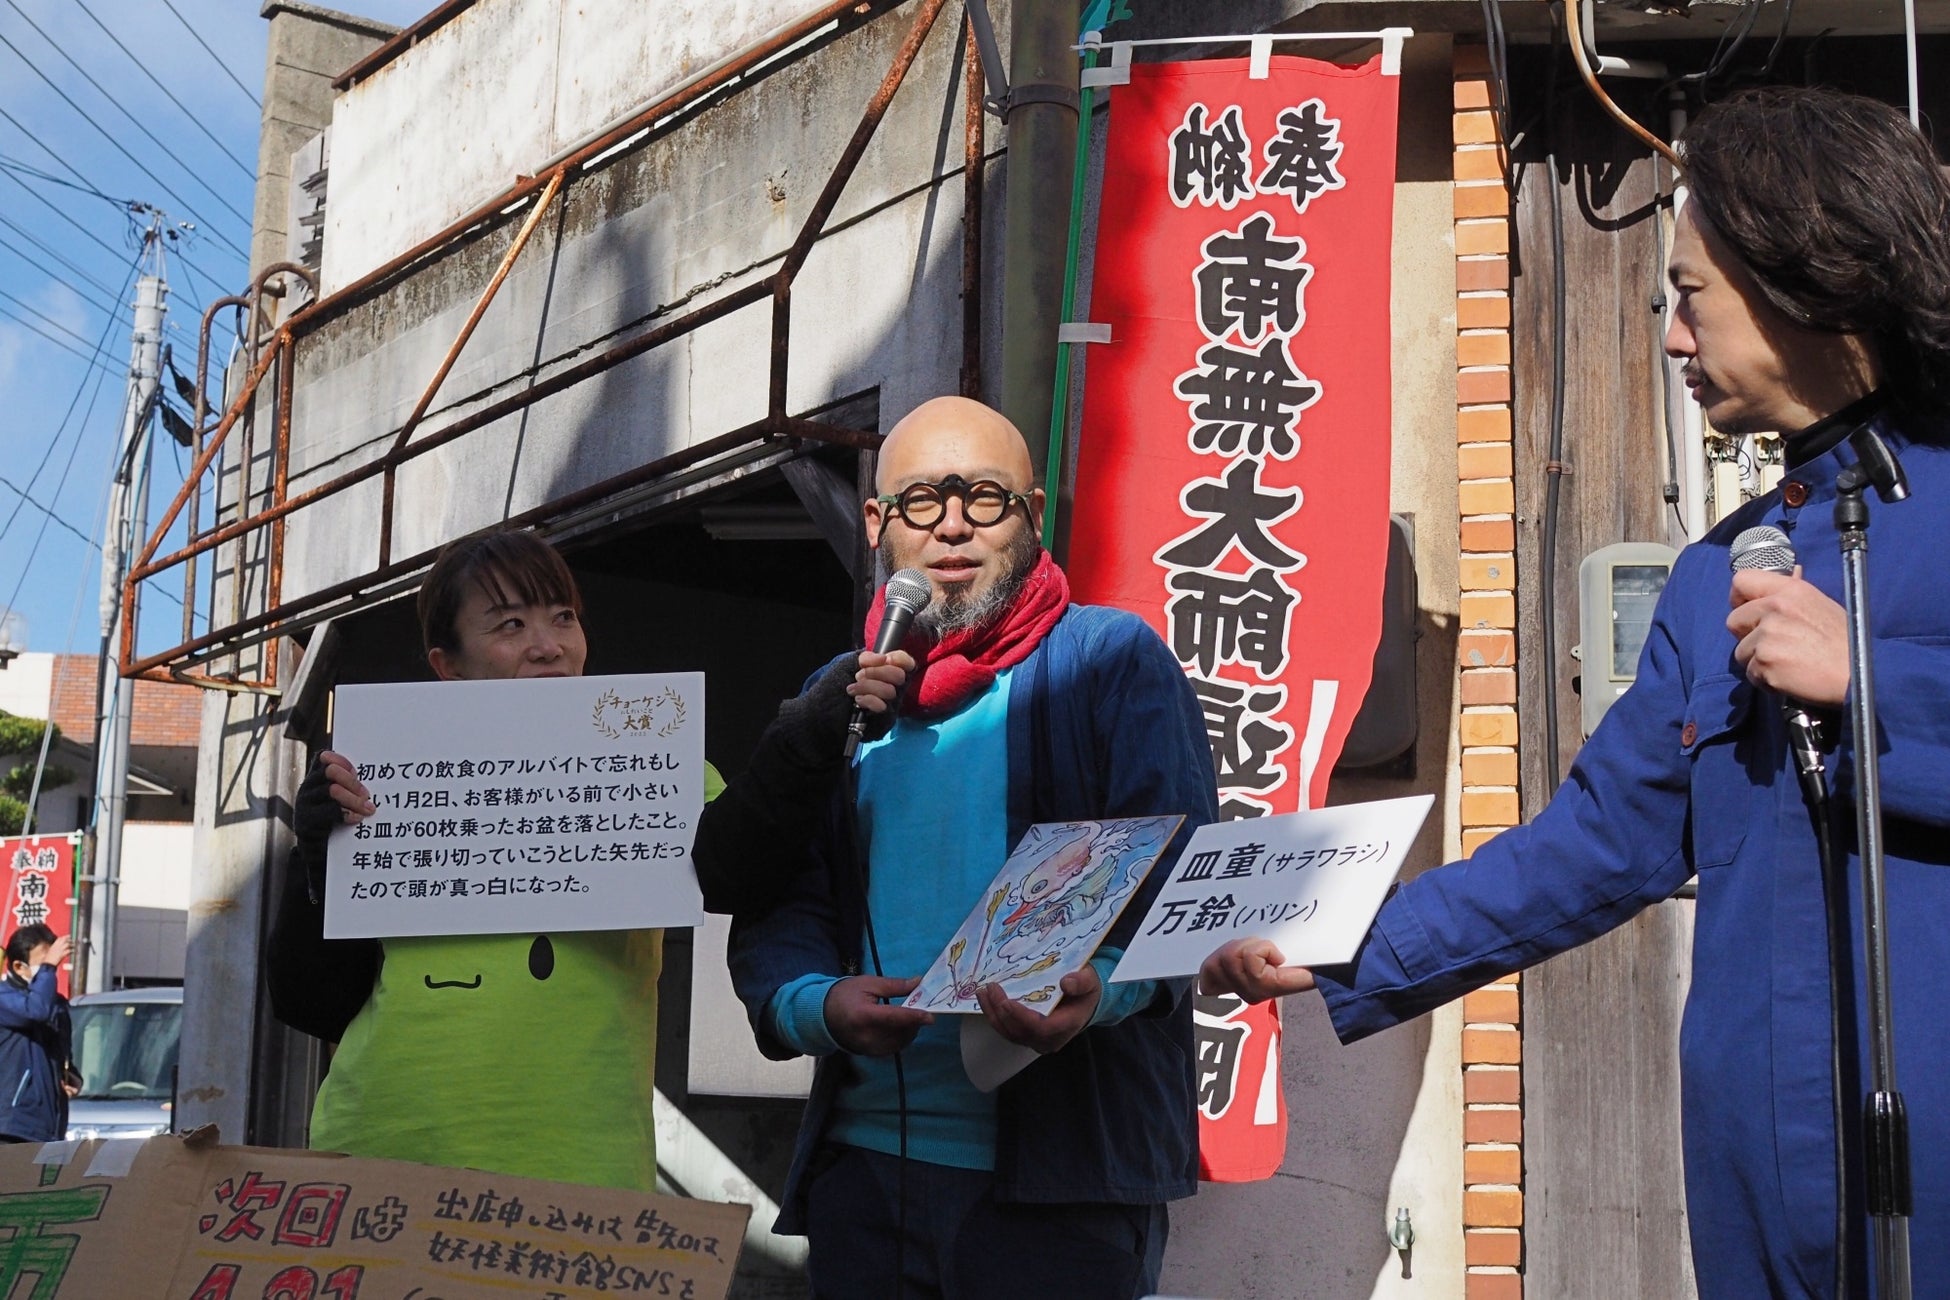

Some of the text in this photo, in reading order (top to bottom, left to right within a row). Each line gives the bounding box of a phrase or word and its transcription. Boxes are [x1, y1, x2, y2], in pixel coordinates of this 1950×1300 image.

[609, 695, 666, 709] チョーケシ
[623, 715, 653, 731] 大賞
[357, 753, 680, 781] 初めての飲食のアルバイトで忘れもし
[368, 782, 679, 809] い1月2日、お客様がいる前で小さい
[354, 811, 687, 840] お皿が60枚乗ったお盆を落としたこと。
[352, 841, 685, 870] 年始で張り切っていこうとした矢先だっ
[350, 874, 590, 900] たので頭が真っ白になった。
[198, 1171, 407, 1247] 次回は
